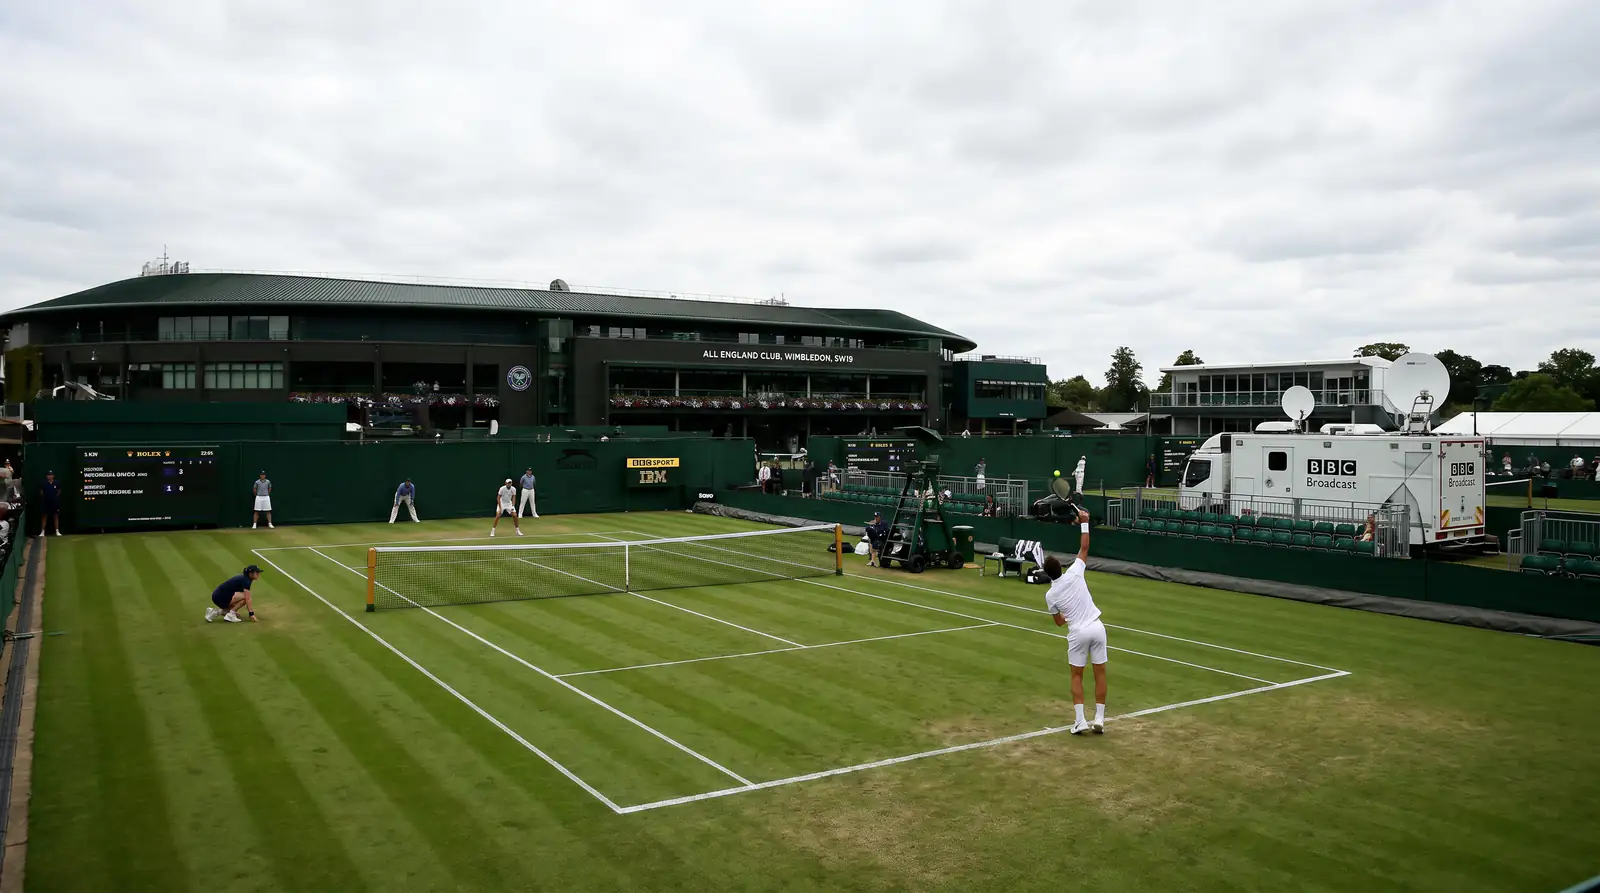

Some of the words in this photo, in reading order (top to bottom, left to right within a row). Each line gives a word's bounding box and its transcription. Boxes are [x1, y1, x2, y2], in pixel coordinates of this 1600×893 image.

[703, 350, 718, 358] ALL
[720, 351, 758, 360] ENGLAND
[760, 352, 783, 361] CLUB,
[785, 353, 833, 363] WIMBLEDON,
[834, 354, 854, 363] SW19
[632, 459, 652, 467] BBC
[1307, 459, 1357, 476] BBC
[1451, 462, 1475, 476] BBC
[639, 470, 667, 484] IBM
[1306, 476, 1357, 490] Broadcast
[1448, 477, 1476, 488] Broadcast
